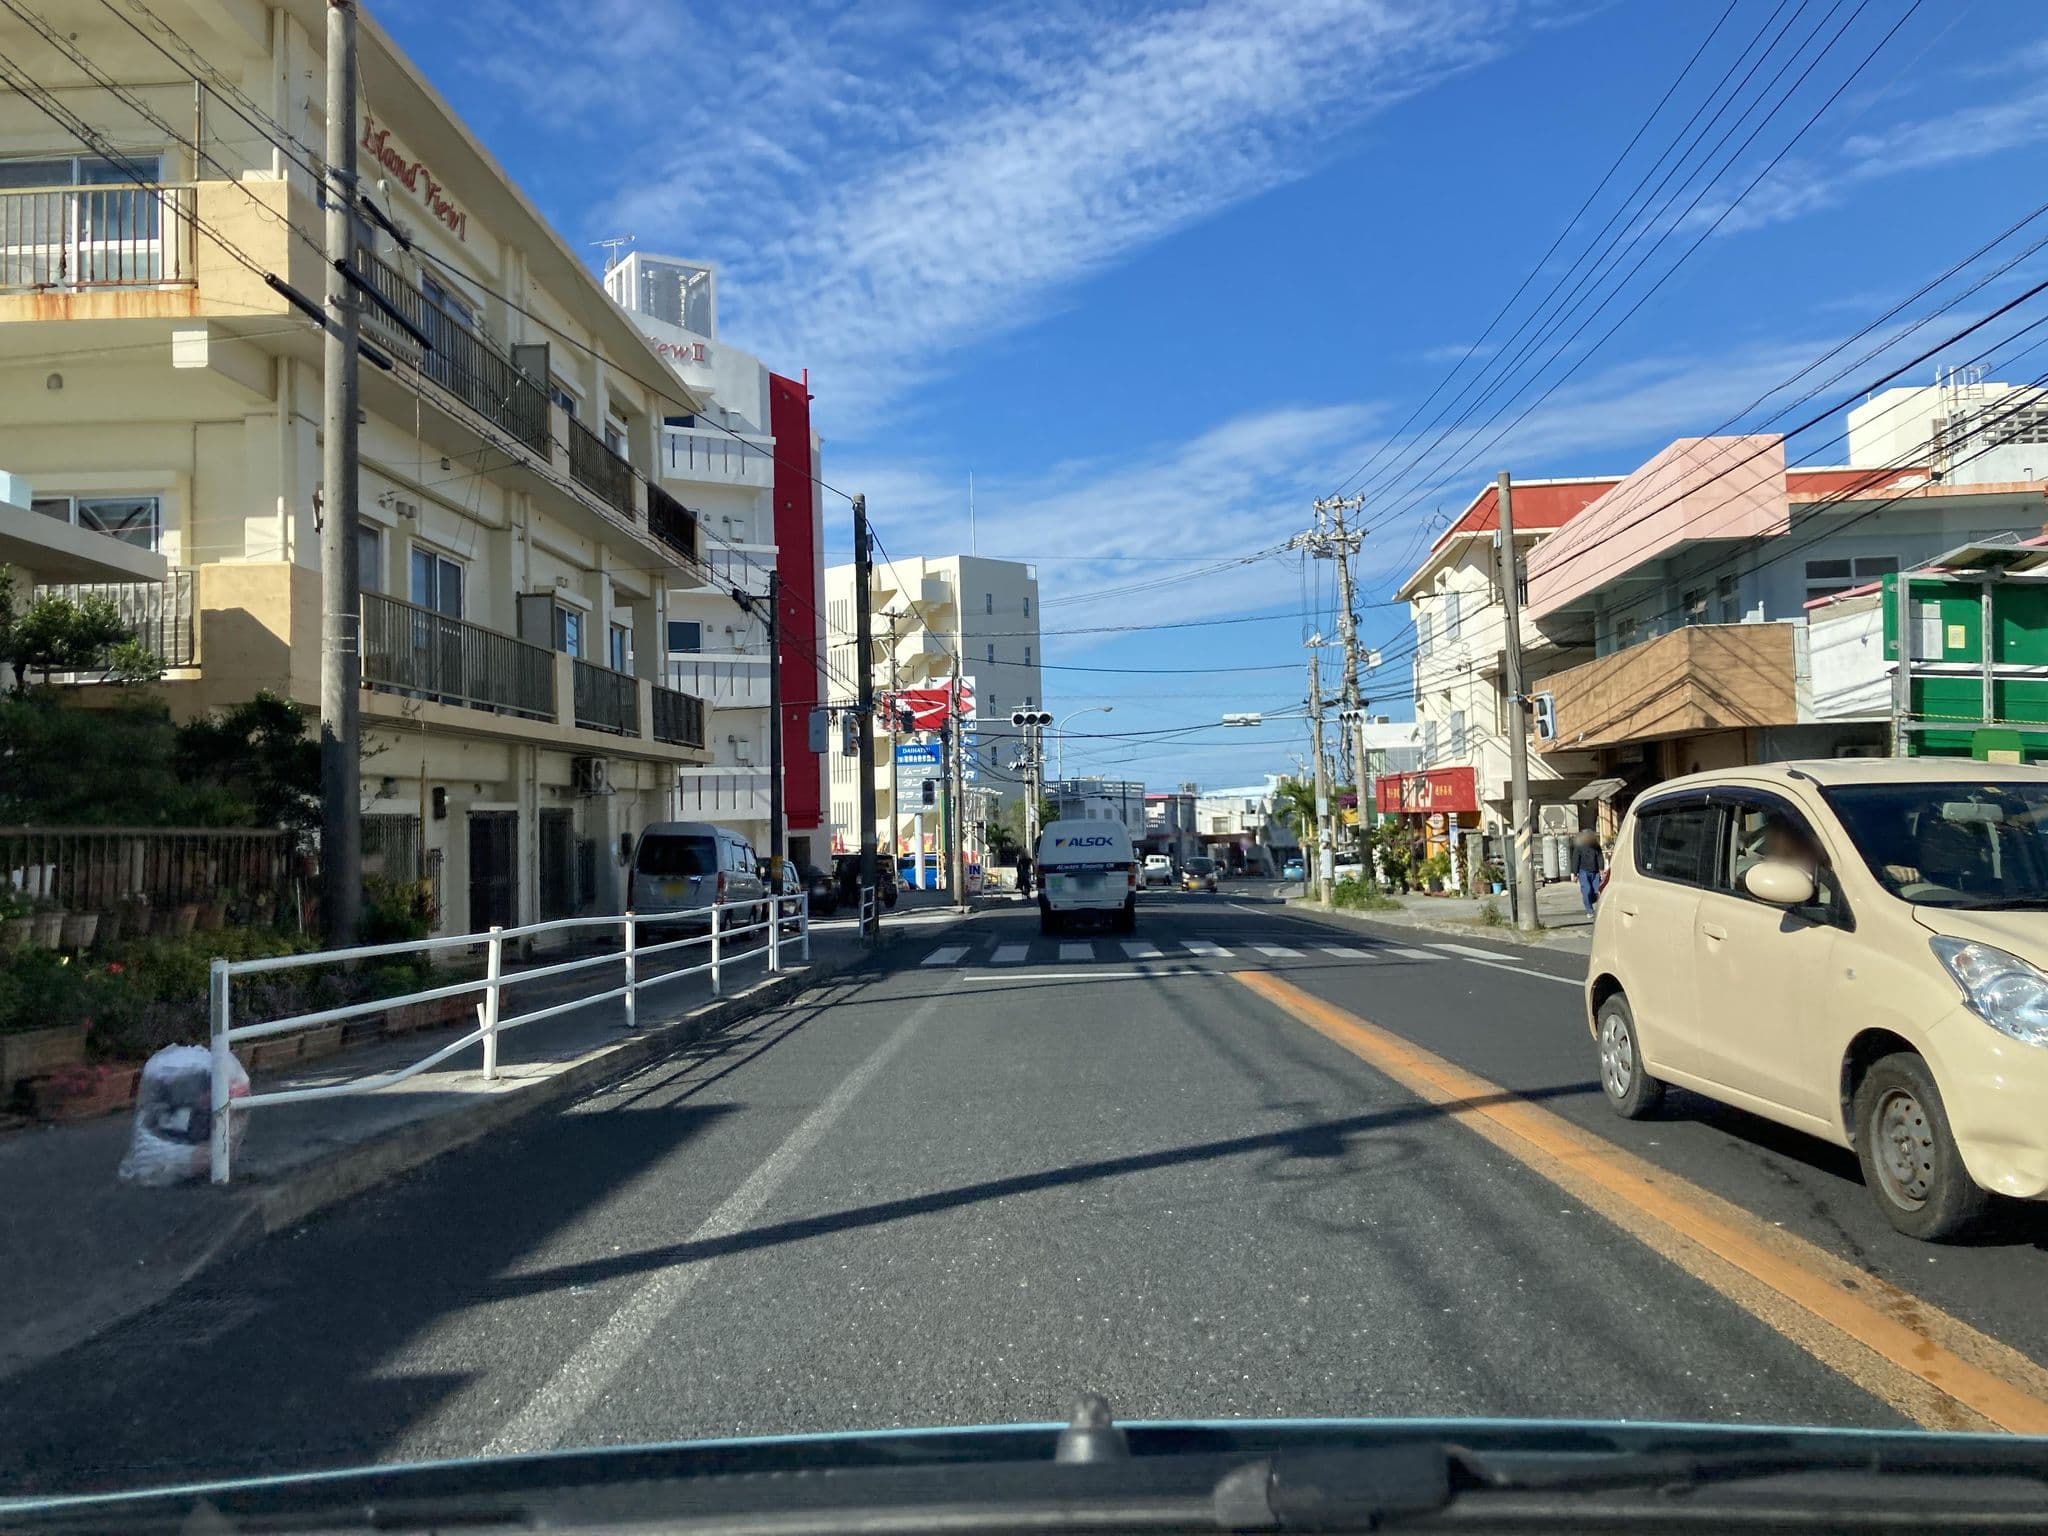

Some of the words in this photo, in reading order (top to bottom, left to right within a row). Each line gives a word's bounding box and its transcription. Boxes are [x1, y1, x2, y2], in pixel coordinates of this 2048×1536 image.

[360, 116, 422, 192] Island
[421, 169, 460, 231] View
[1069, 837, 1113, 847] ALSOK
[969, 865, 981, 875] IN
